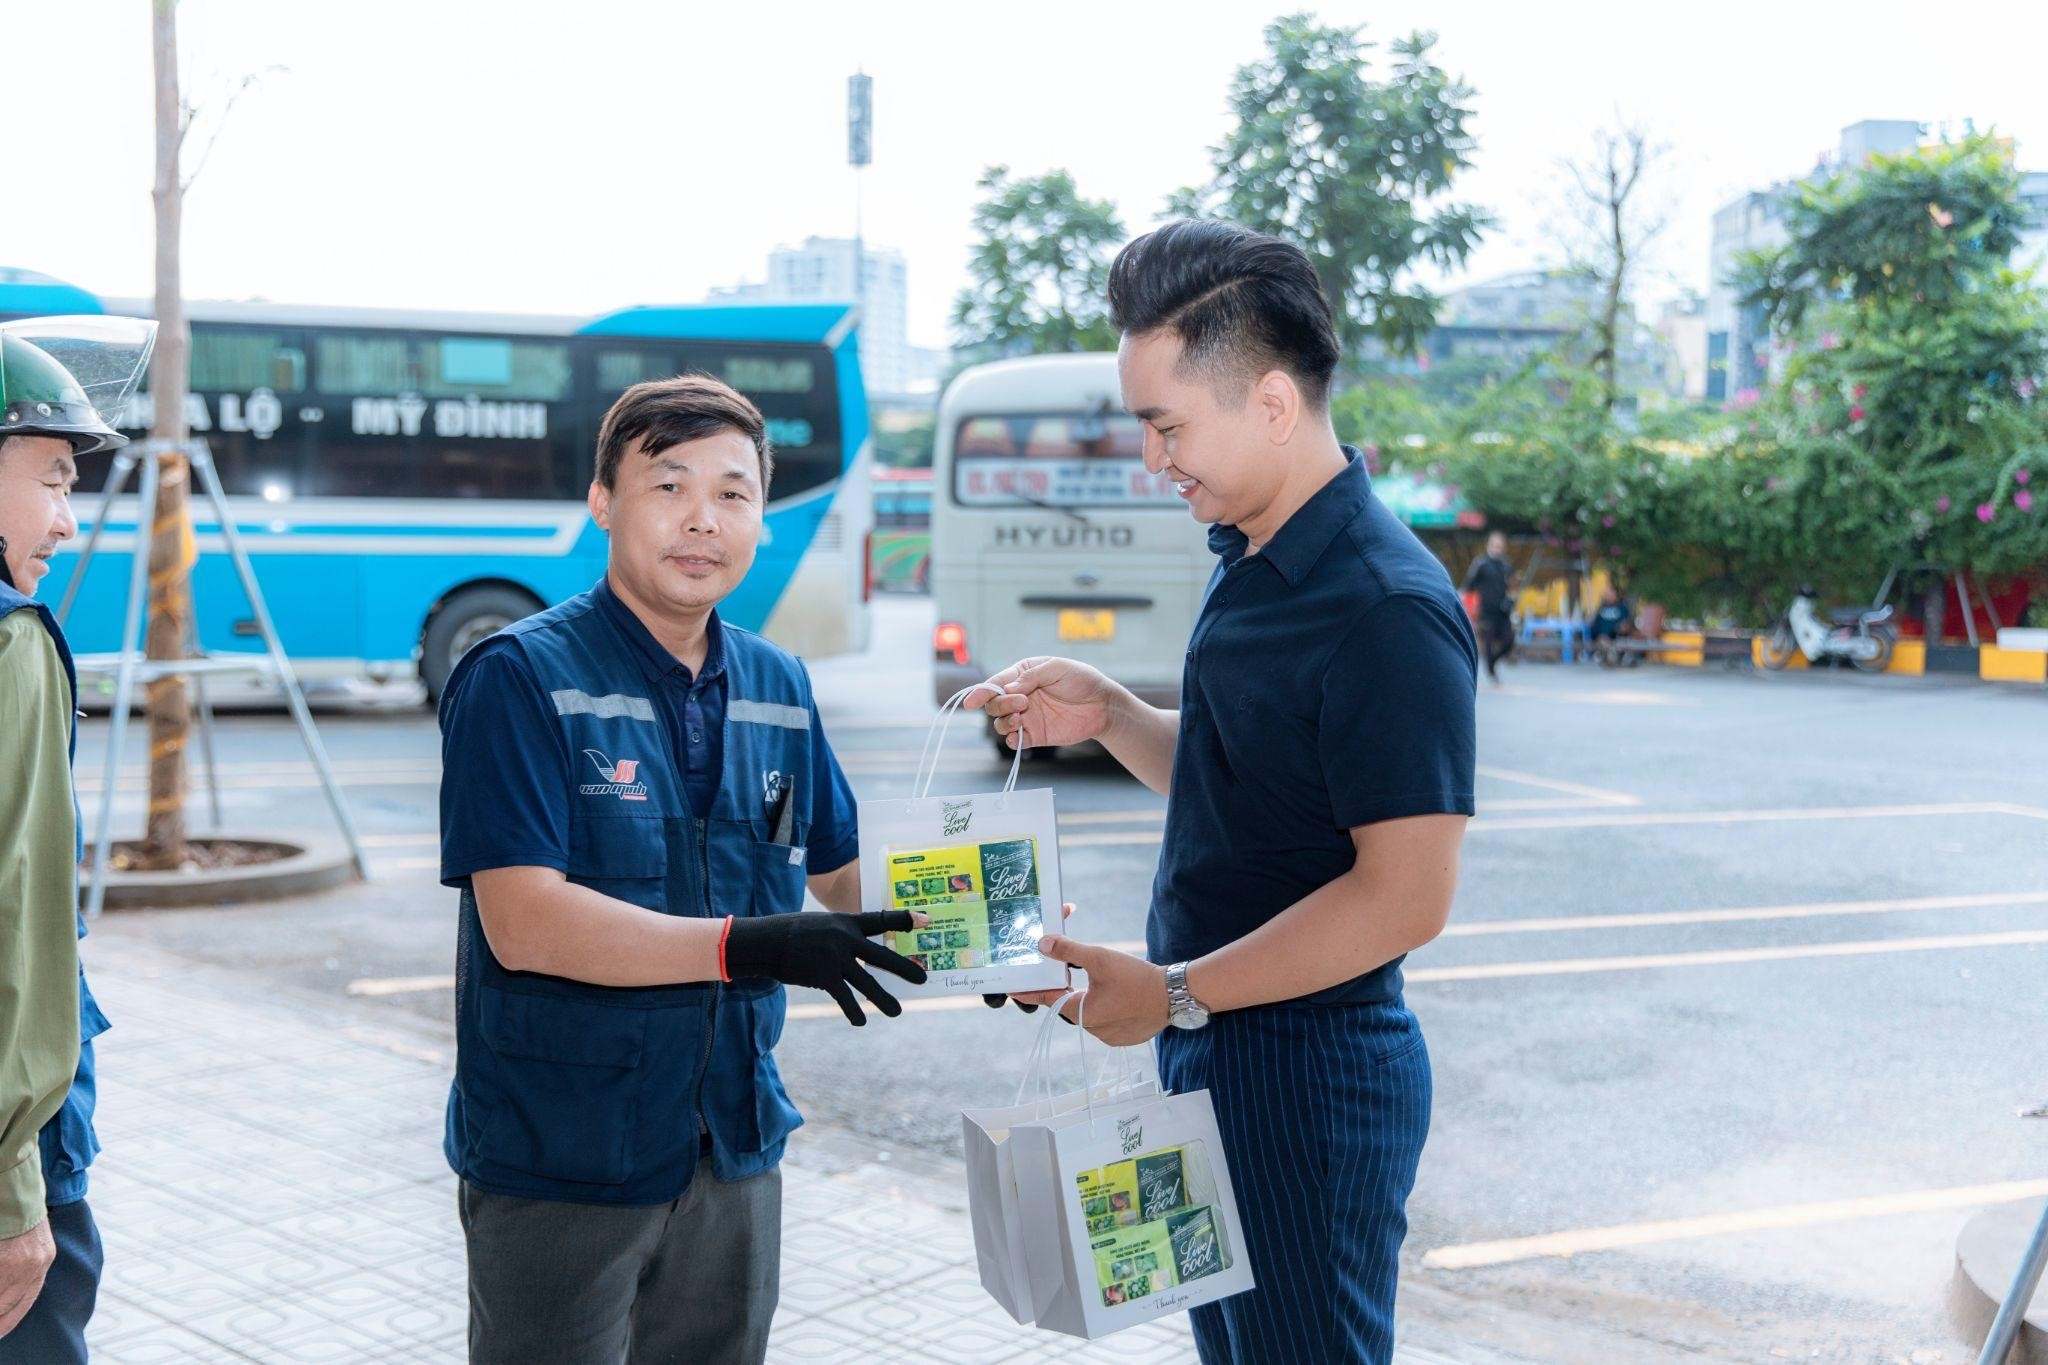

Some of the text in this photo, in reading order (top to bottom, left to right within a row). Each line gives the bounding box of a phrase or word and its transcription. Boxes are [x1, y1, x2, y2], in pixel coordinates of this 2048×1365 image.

[219, 386, 283, 439] LỘ
[433, 393, 548, 439] ĐÌNH
[943, 811, 968, 829] Live
[944, 812, 972, 837] cool
[989, 866, 1024, 892] Live
[1123, 1125, 1143, 1156] cool
[1144, 1179, 1174, 1208] Live
[1180, 1236, 1208, 1265] Live
[1182, 1233, 1214, 1277] cool
